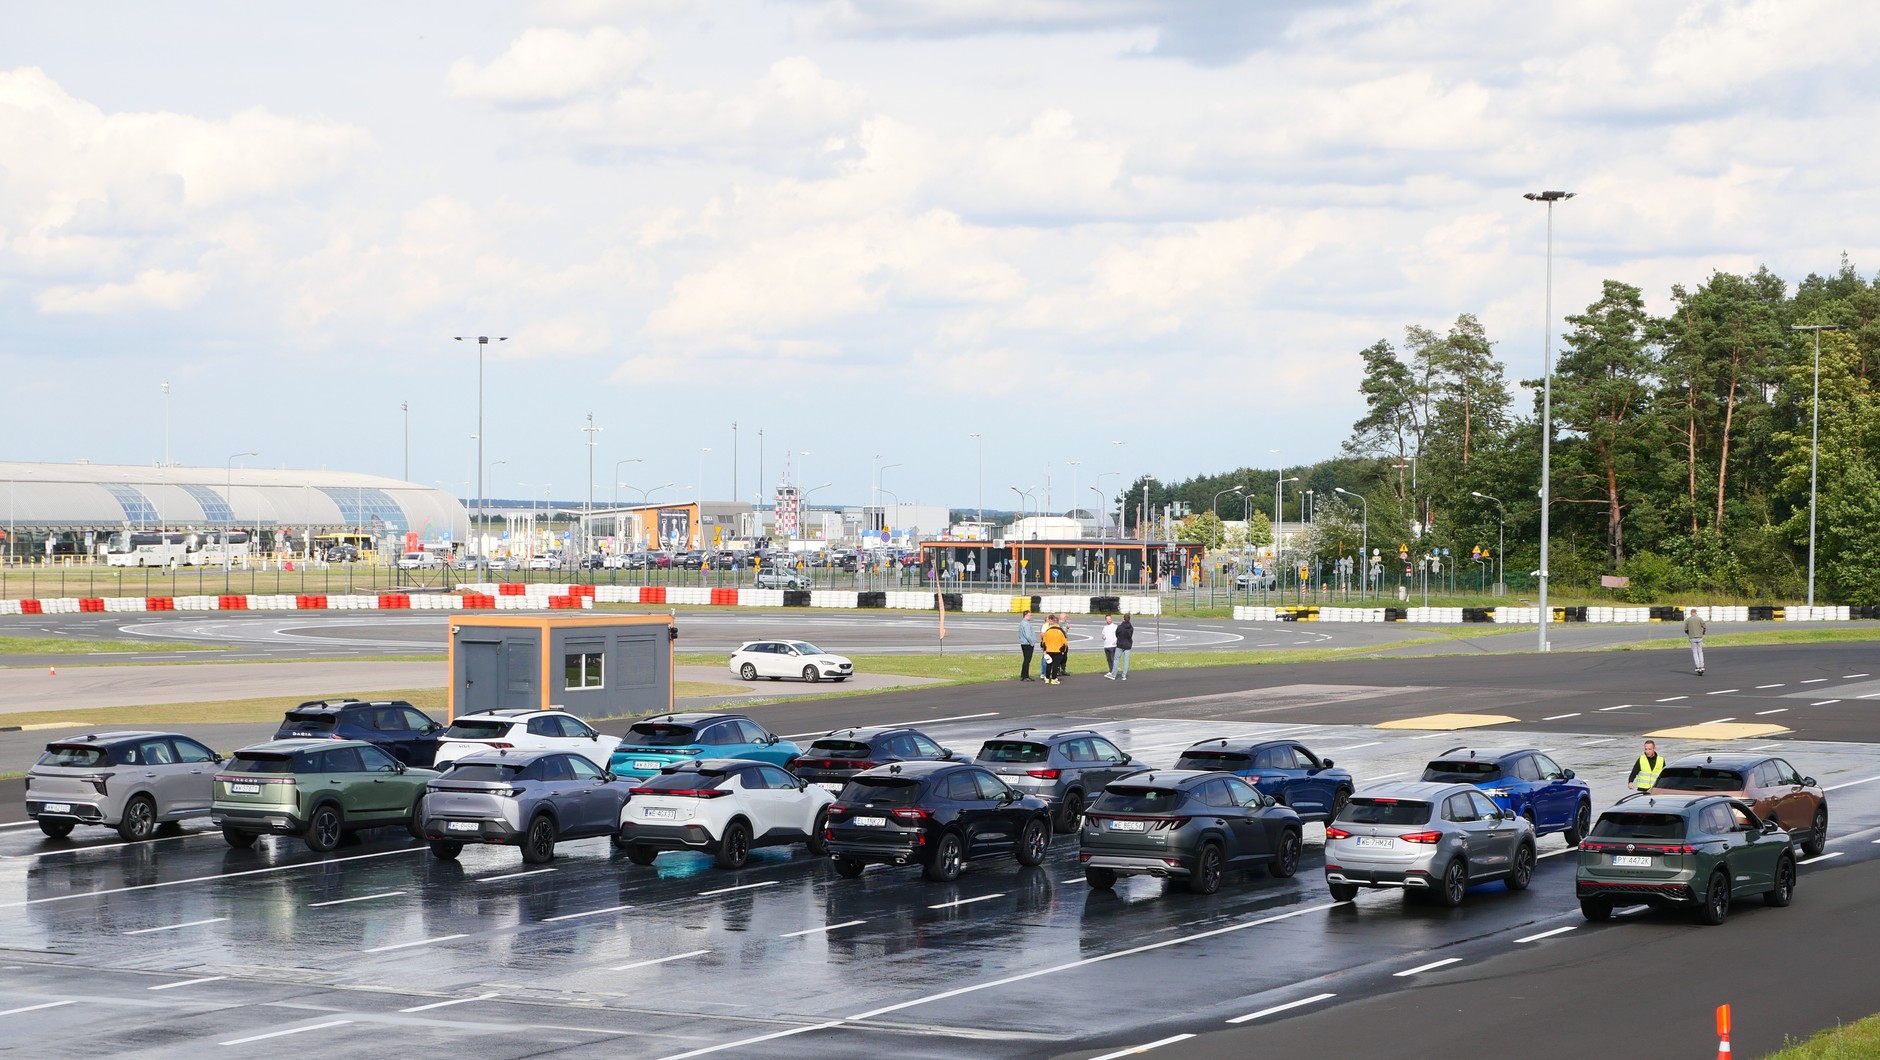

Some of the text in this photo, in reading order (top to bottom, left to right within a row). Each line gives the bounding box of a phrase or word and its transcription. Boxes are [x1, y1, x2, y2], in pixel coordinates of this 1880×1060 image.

[1361, 838, 1392, 848] WE 7HM24
[1617, 856, 1650, 866] PY 4472K
